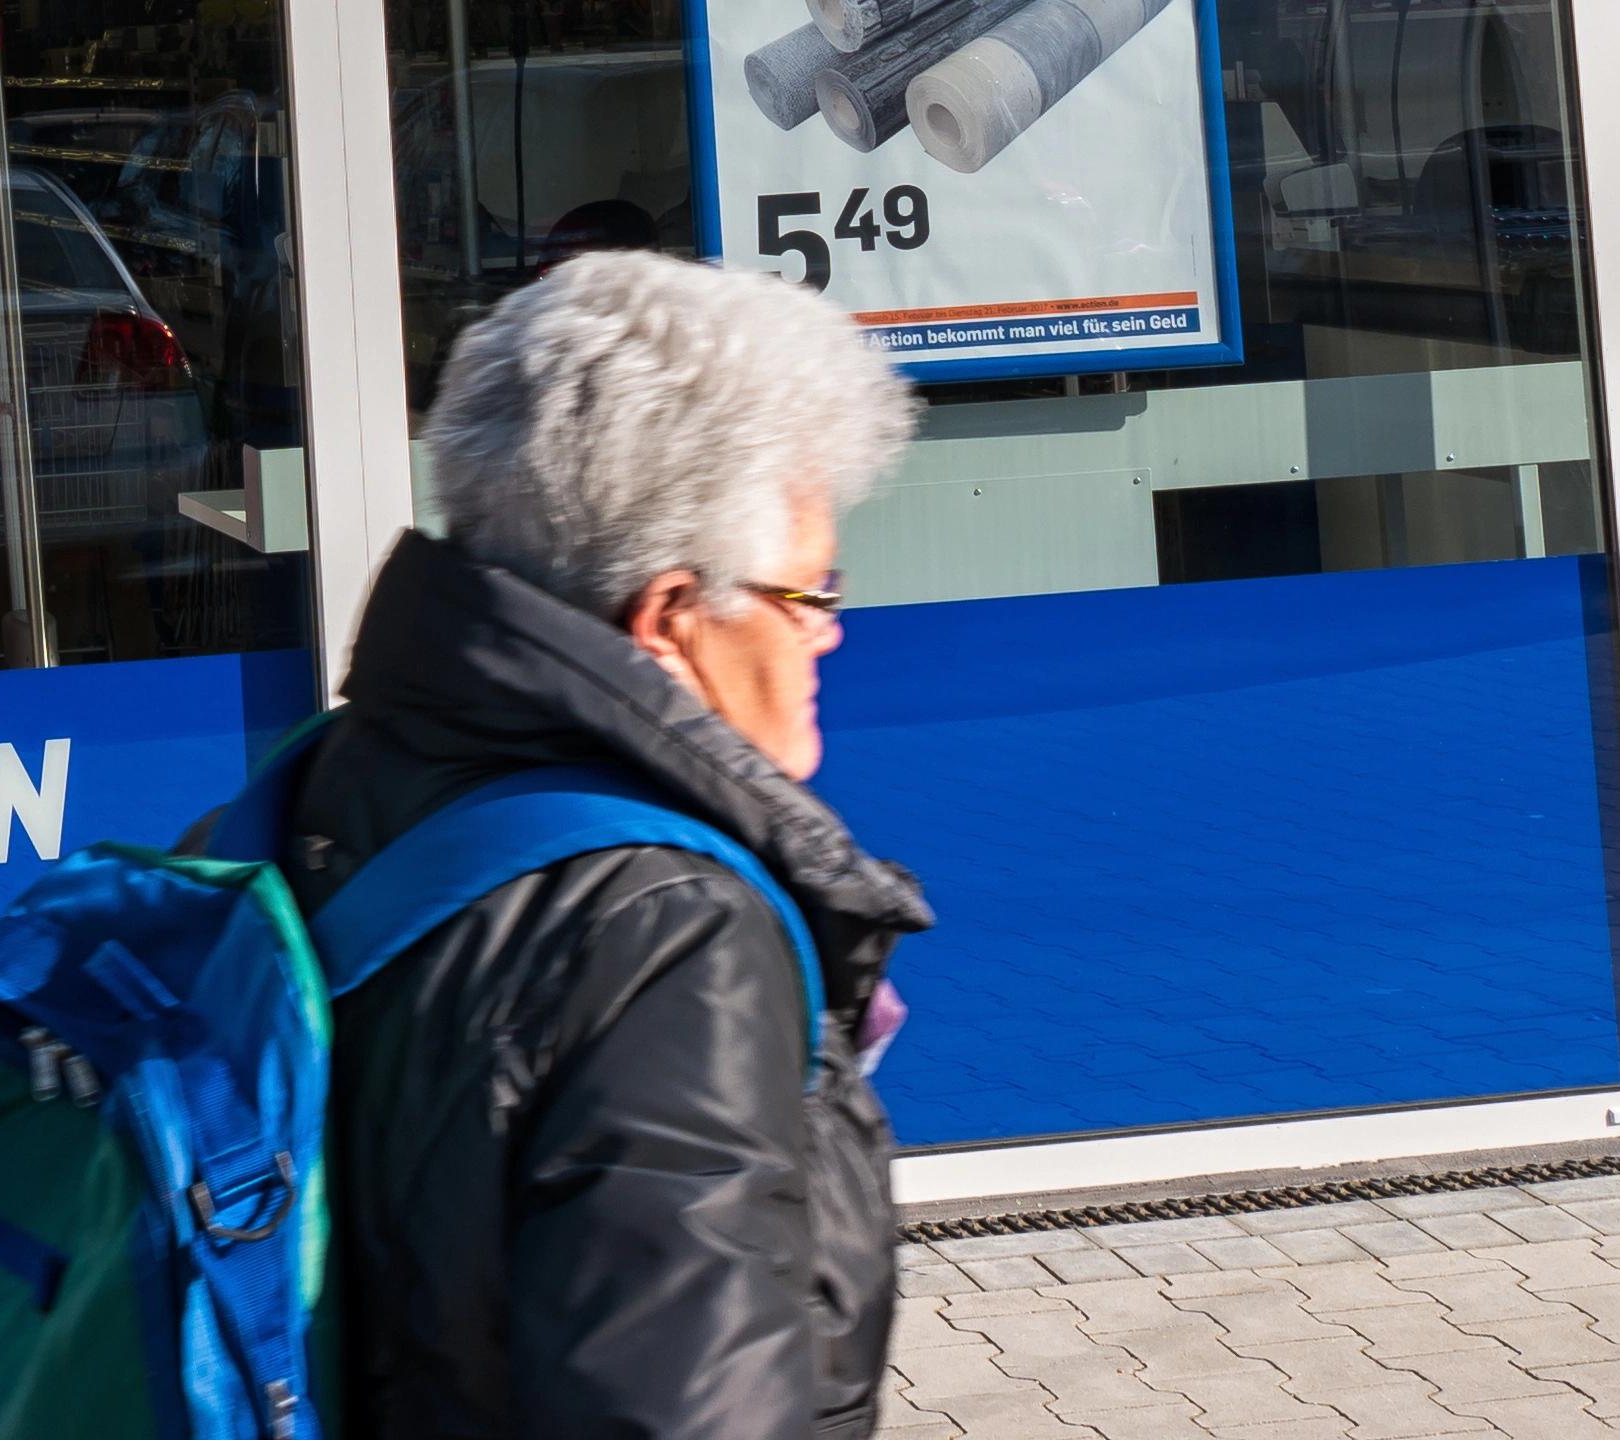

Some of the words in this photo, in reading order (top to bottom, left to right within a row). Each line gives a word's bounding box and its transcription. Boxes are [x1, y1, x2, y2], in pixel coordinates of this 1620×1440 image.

[870, 331, 923, 348] Action
[927, 326, 1005, 344] bekommt
[1009, 326, 1045, 338] man
[1049, 320, 1079, 335] viel
[1083, 318, 1107, 334] für
[1112, 316, 1146, 332] sein
[1150, 313, 1188, 329] Geld
